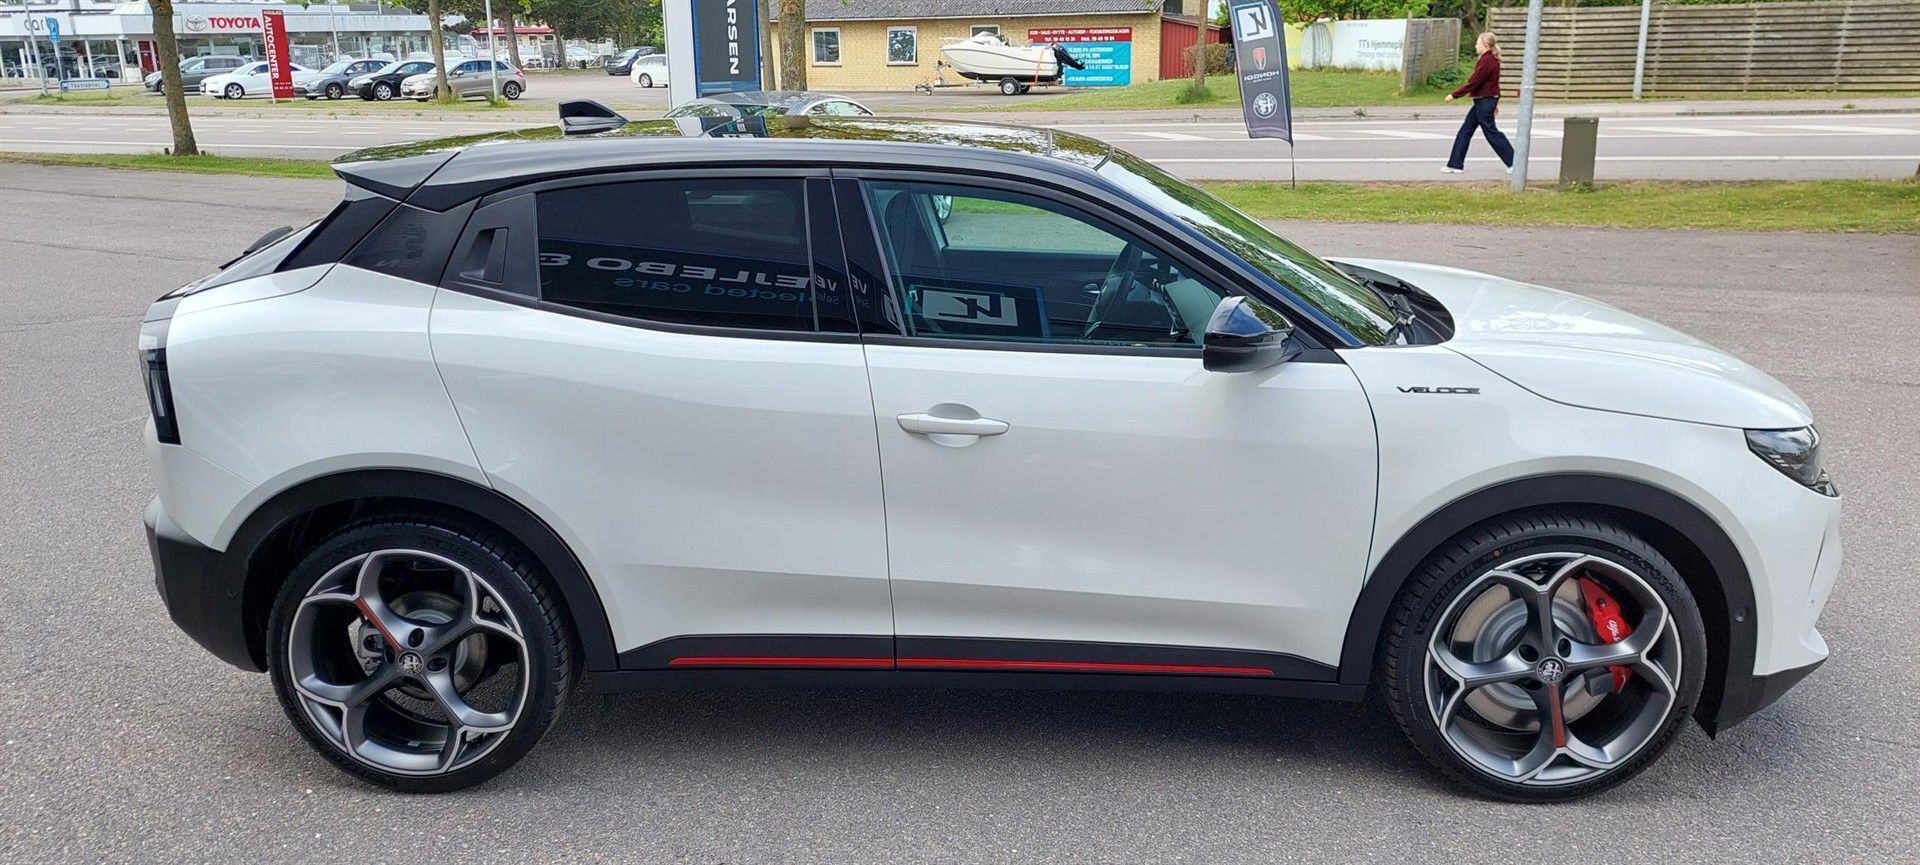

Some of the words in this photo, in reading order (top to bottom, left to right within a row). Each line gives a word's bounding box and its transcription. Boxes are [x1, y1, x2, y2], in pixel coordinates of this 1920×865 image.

[208, 17, 261, 29] TOYOTA
[264, 15, 280, 79] AUTOCENTER
[1396, 386, 1480, 394] VELOCE
